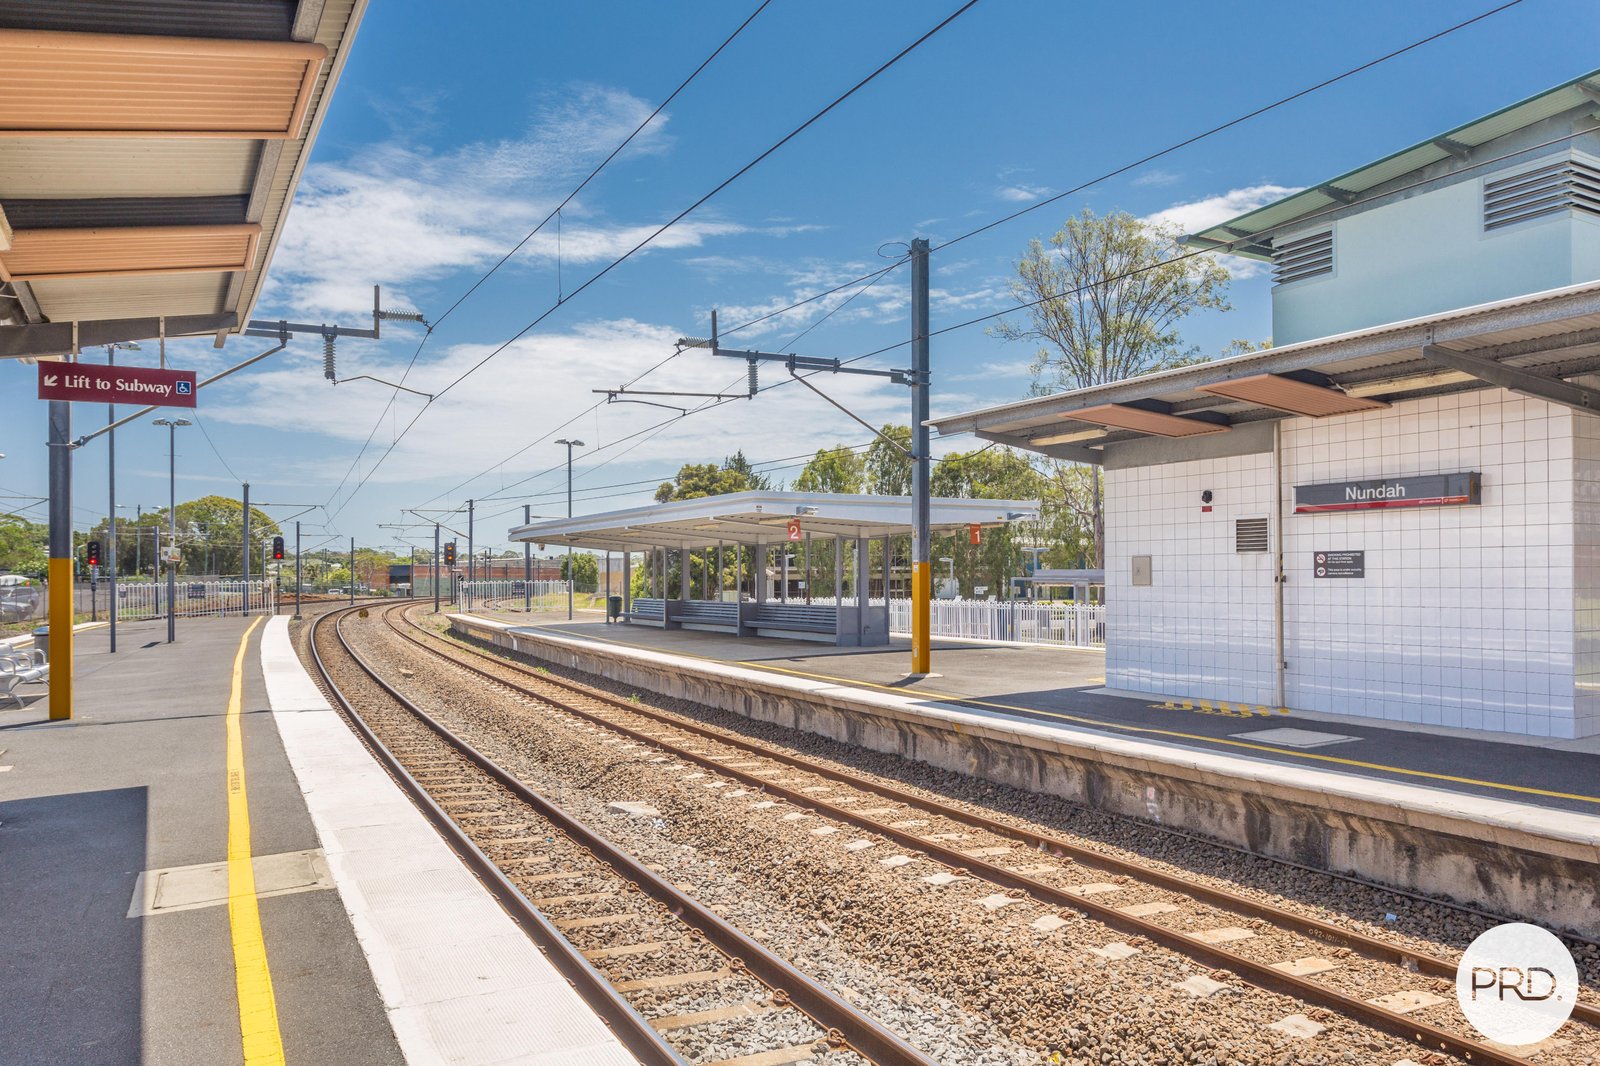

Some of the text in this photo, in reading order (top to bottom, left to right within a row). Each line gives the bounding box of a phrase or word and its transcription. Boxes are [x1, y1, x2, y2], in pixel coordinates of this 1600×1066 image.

[65, 375, 172, 397] Lift to Subway
[1346, 484, 1406, 500] Nundah
[790, 525, 799, 539] 2
